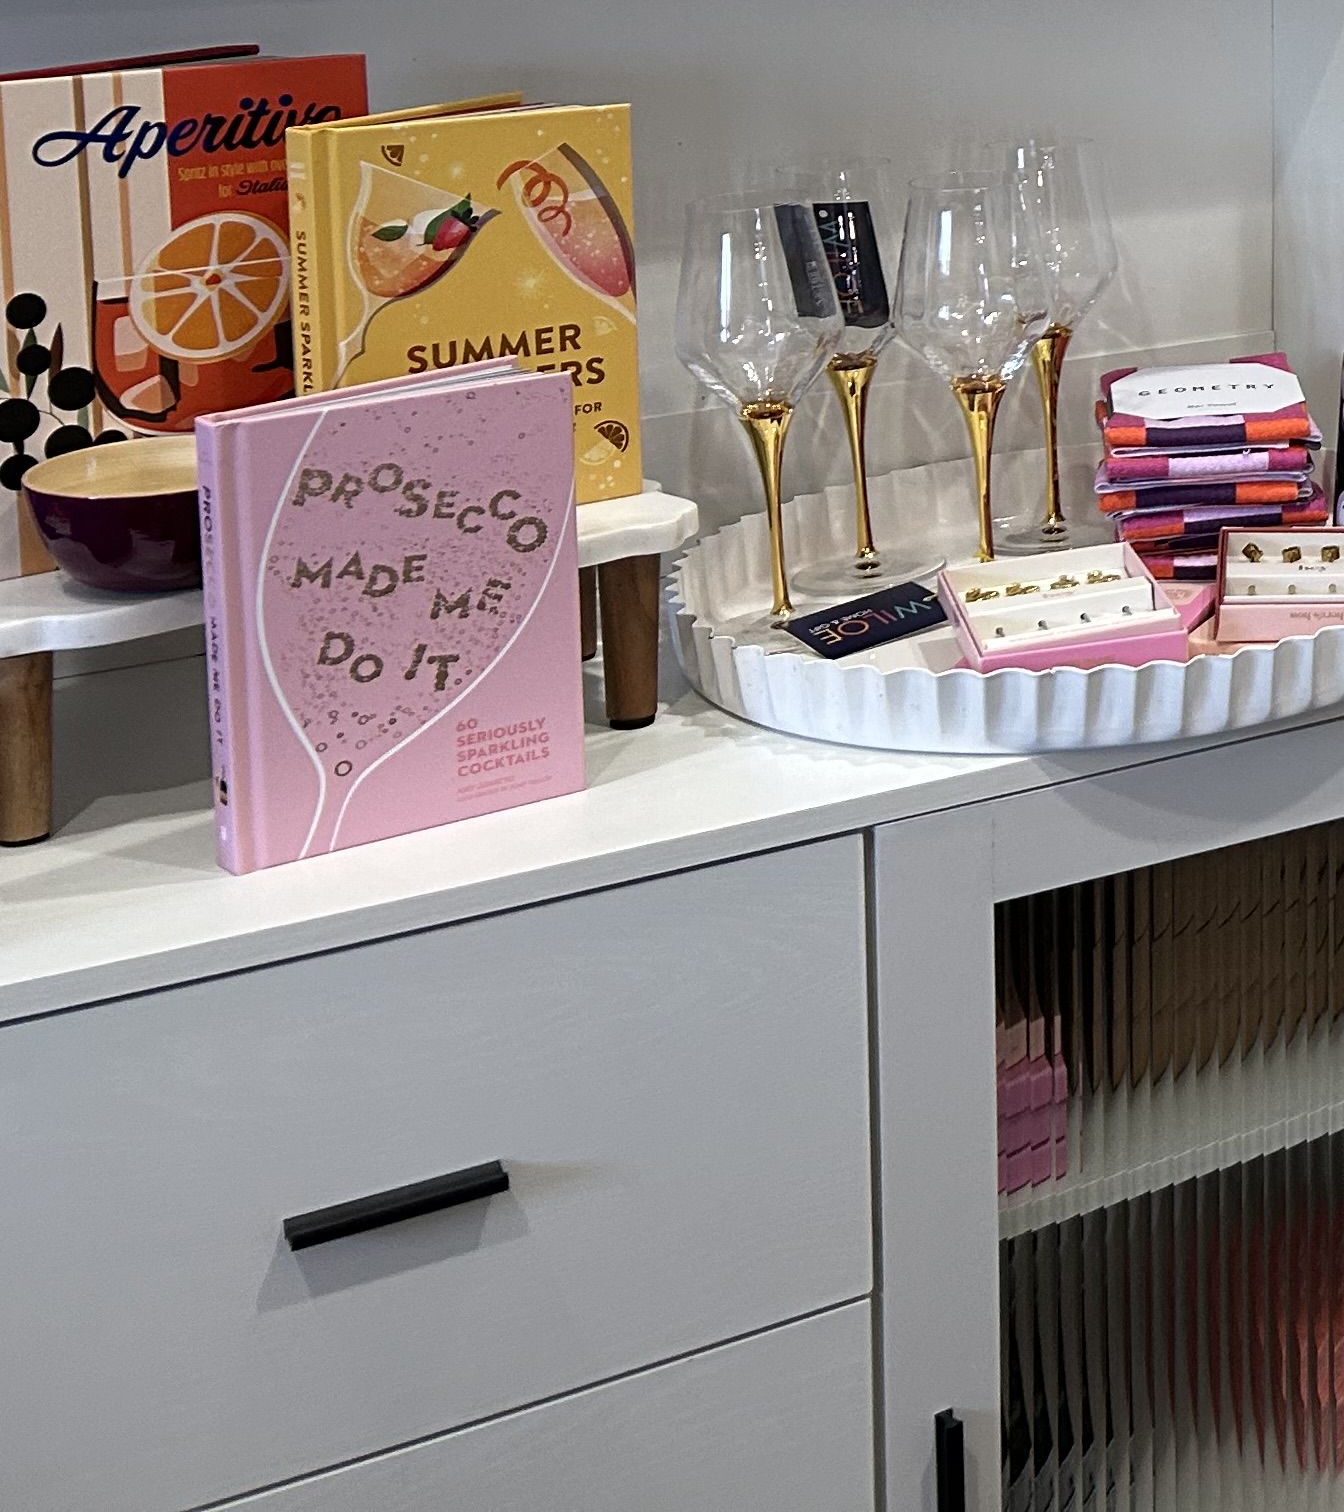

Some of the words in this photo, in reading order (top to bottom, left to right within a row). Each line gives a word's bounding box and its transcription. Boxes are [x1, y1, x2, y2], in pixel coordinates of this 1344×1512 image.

[296, 231, 310, 317] SUMMER
[301, 322, 314, 393] SPARKL
[407, 324, 582, 374] SUMMER
[574, 402, 602, 415] FOR
[1138, 383, 1274, 397] GEOMETRY
[293, 463, 548, 554] PROSECCO
[290, 552, 427, 597] MADE
[430, 578, 511, 619] ME
[211, 616, 219, 662] MADE
[814, 600, 932, 645] WILOE
[317, 631, 384, 683] DO
[404, 643, 460, 691] IT
[456, 718, 478, 732] 60
[457, 717, 546, 747] SERIOUSLY
[457, 732, 549, 762] SPARKLING
[458, 747, 550, 777] COCKTAILS
